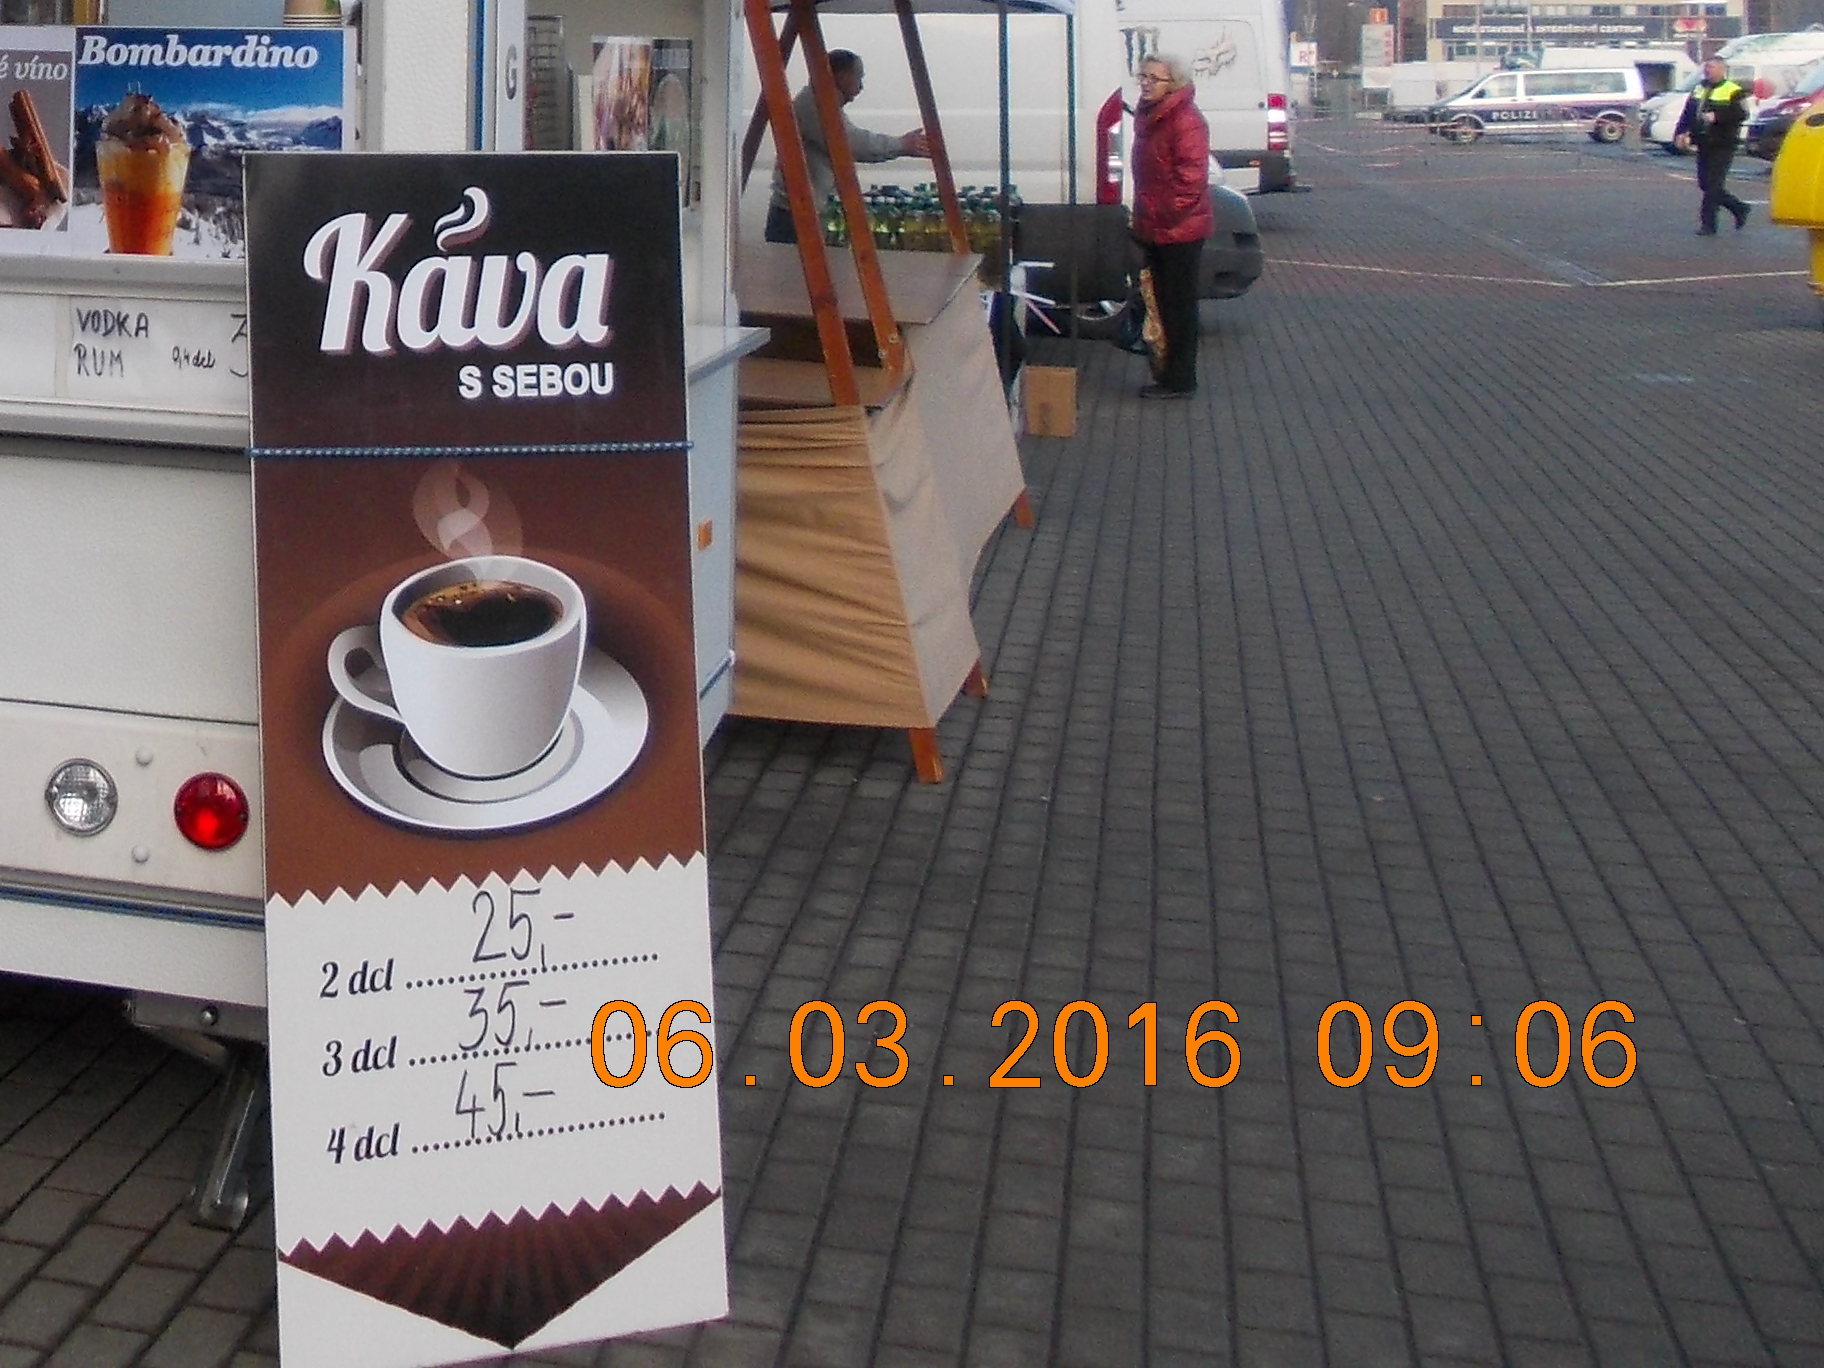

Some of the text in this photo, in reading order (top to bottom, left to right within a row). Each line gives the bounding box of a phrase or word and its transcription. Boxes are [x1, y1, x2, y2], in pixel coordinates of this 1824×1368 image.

[12, 54, 69, 82] víno
[78, 31, 319, 70] Bombardino
[303, 186, 615, 355] Káva
[76, 306, 150, 338] VODKA
[73, 342, 125, 377] RUM
[458, 361, 615, 399] S SEBOU
[472, 887, 575, 973] 25,-
[319, 957, 395, 999] 2 dcl
[322, 1035, 398, 1077] 3 dcl
[327, 1123, 401, 1164] 4 dcl
